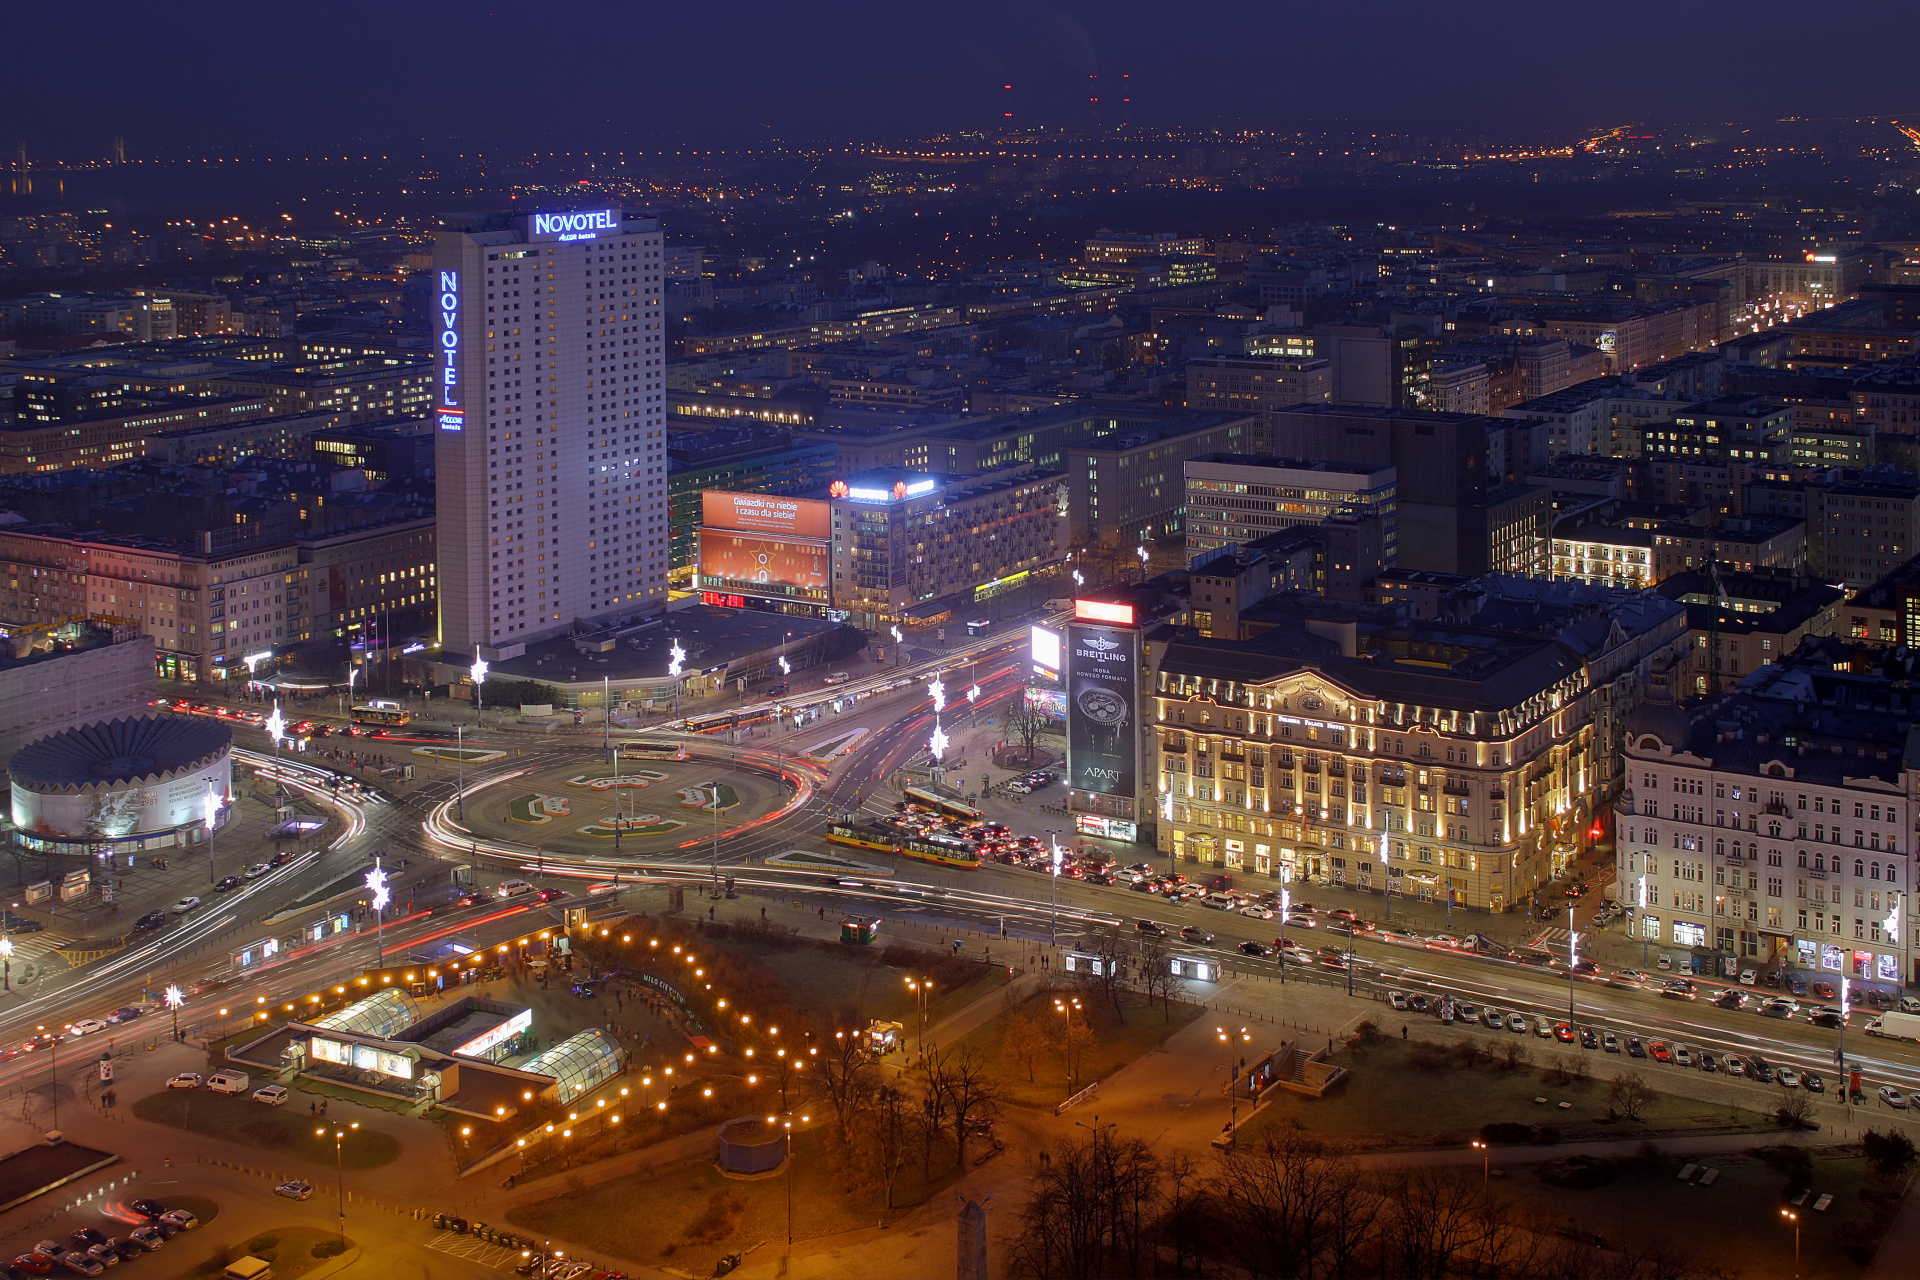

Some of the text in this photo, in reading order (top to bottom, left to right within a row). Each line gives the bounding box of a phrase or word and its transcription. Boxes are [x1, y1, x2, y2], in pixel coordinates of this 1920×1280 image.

[535, 209, 617, 235] NOVOTEL
[578, 232, 596, 240] hotels
[440, 271, 458, 406] NOVOTEL
[441, 423, 461, 431] hotels
[734, 498, 765, 508] Gwiazdki
[777, 502, 798, 510] niebie
[736, 506, 738, 514] i
[761, 509, 772, 517] dla
[773, 510, 795, 519] siebie!
[1076, 649, 1126, 662] BREITLING
[1084, 766, 1122, 783] APART
